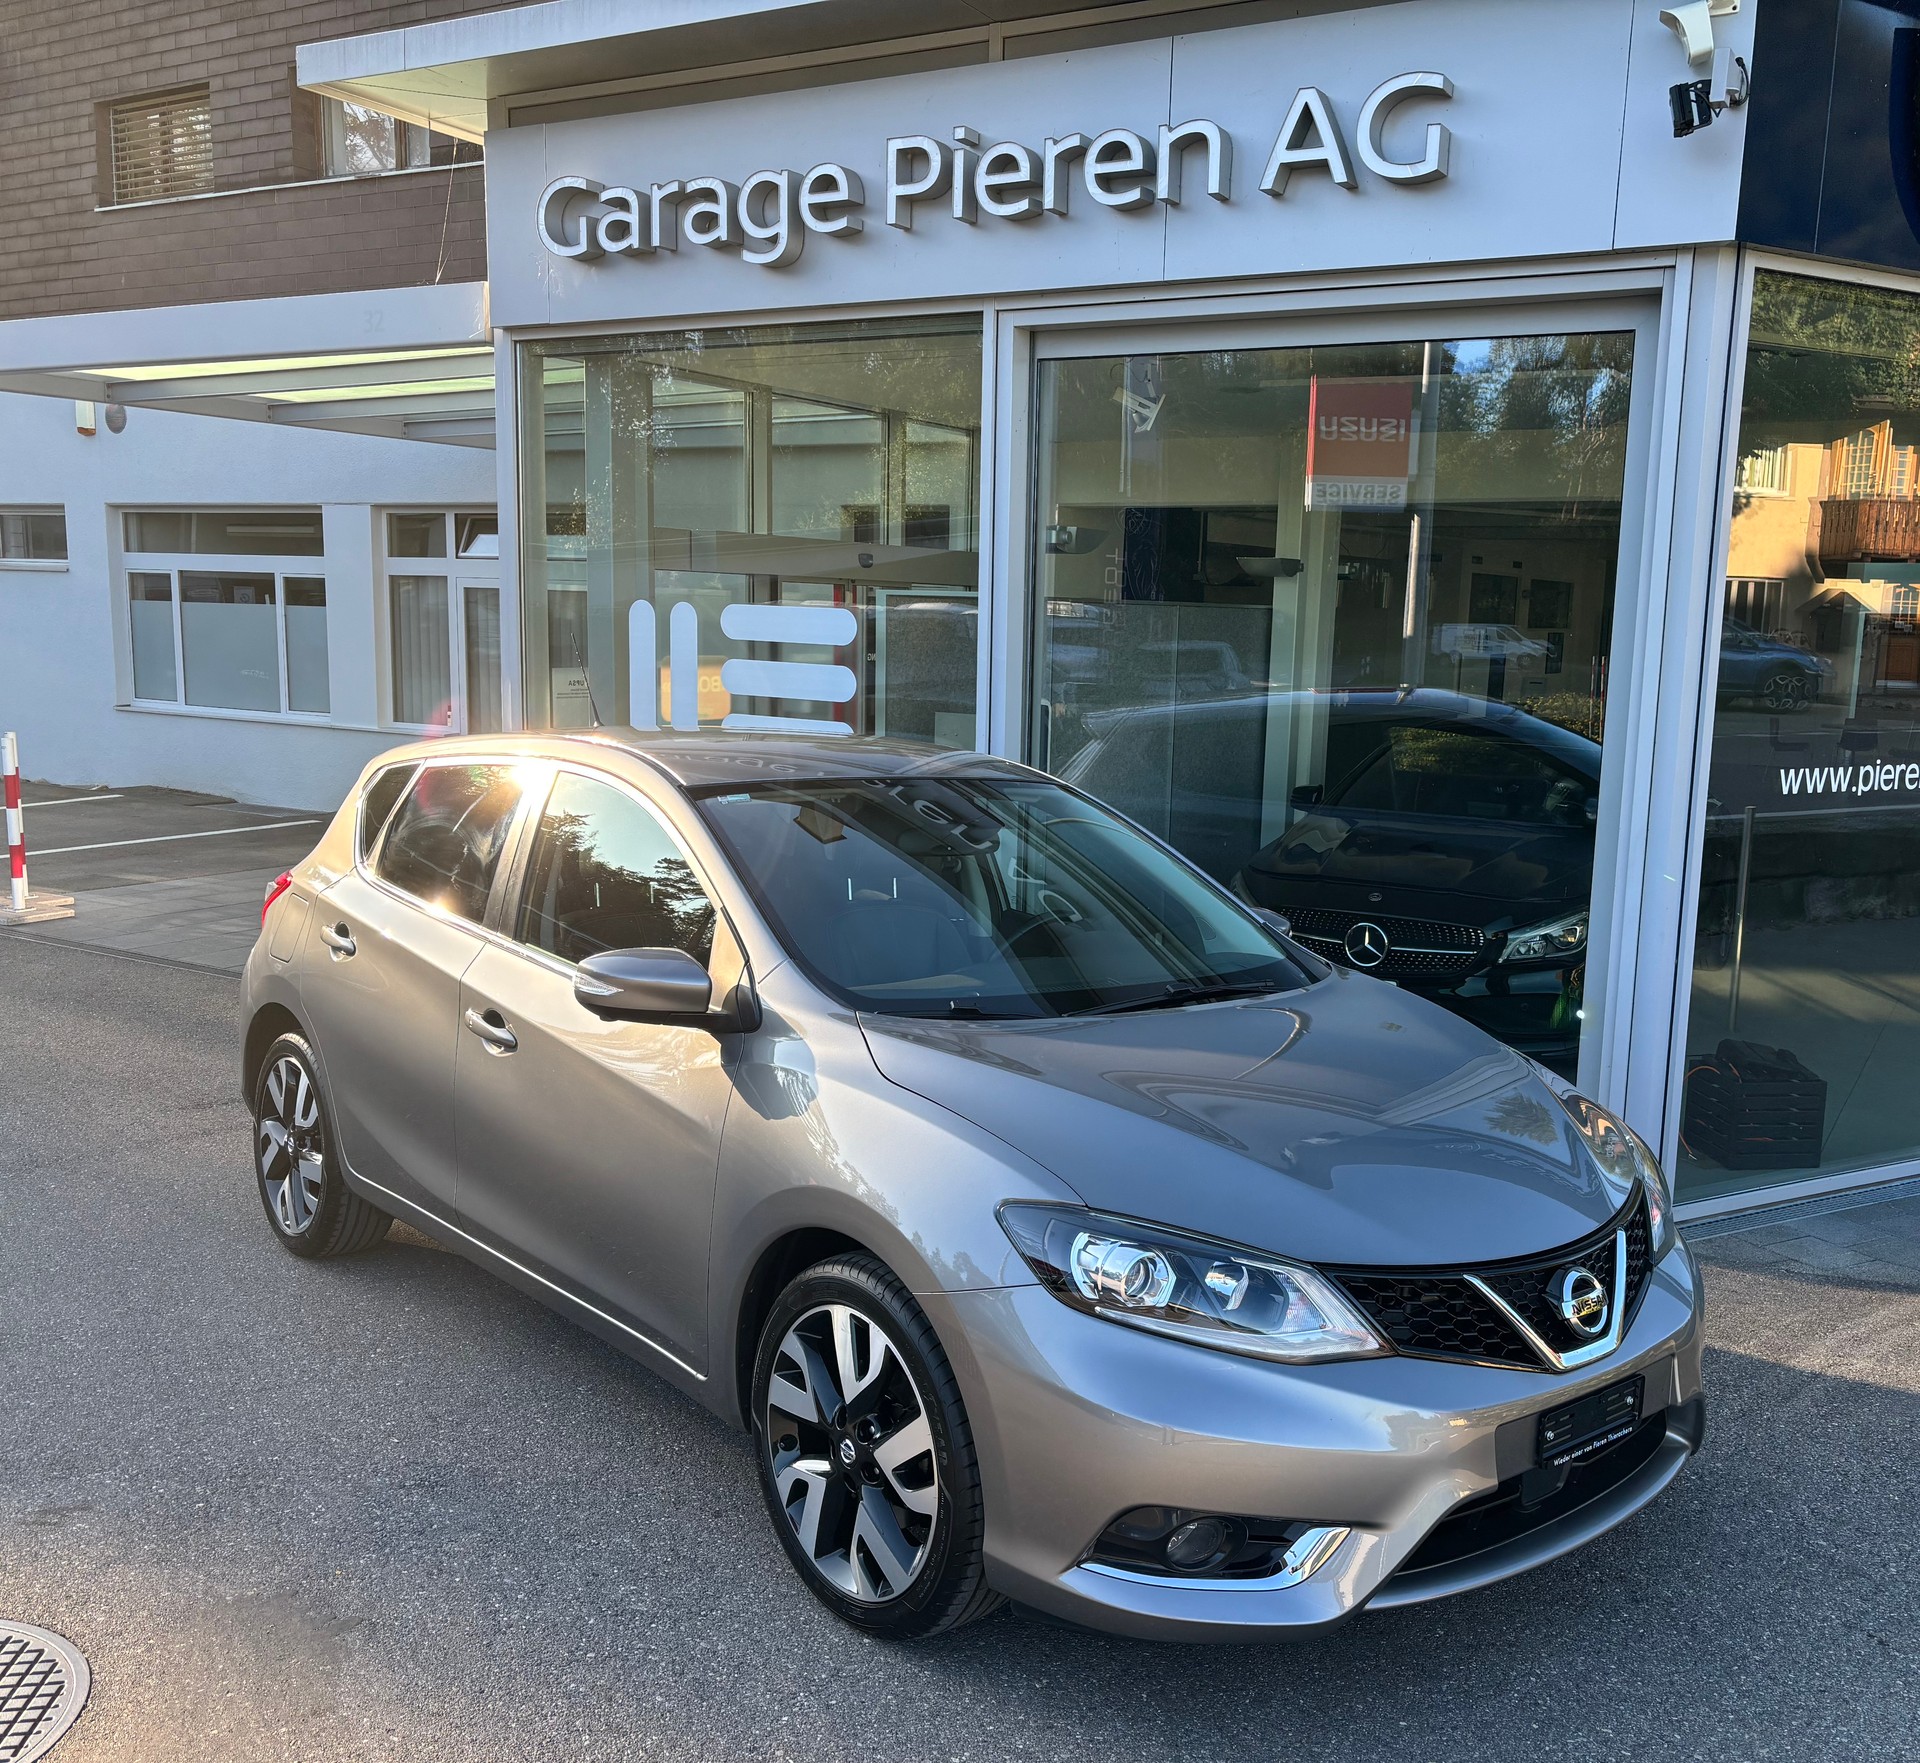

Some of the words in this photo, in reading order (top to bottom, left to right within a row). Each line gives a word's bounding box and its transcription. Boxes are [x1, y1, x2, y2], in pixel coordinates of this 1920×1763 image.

[536, 163, 864, 267] Garage
[885, 118, 1232, 230] Pieren
[1258, 71, 1454, 196] AG
[363, 310, 385, 332] 32
[1780, 759, 1920, 796] www.piere
